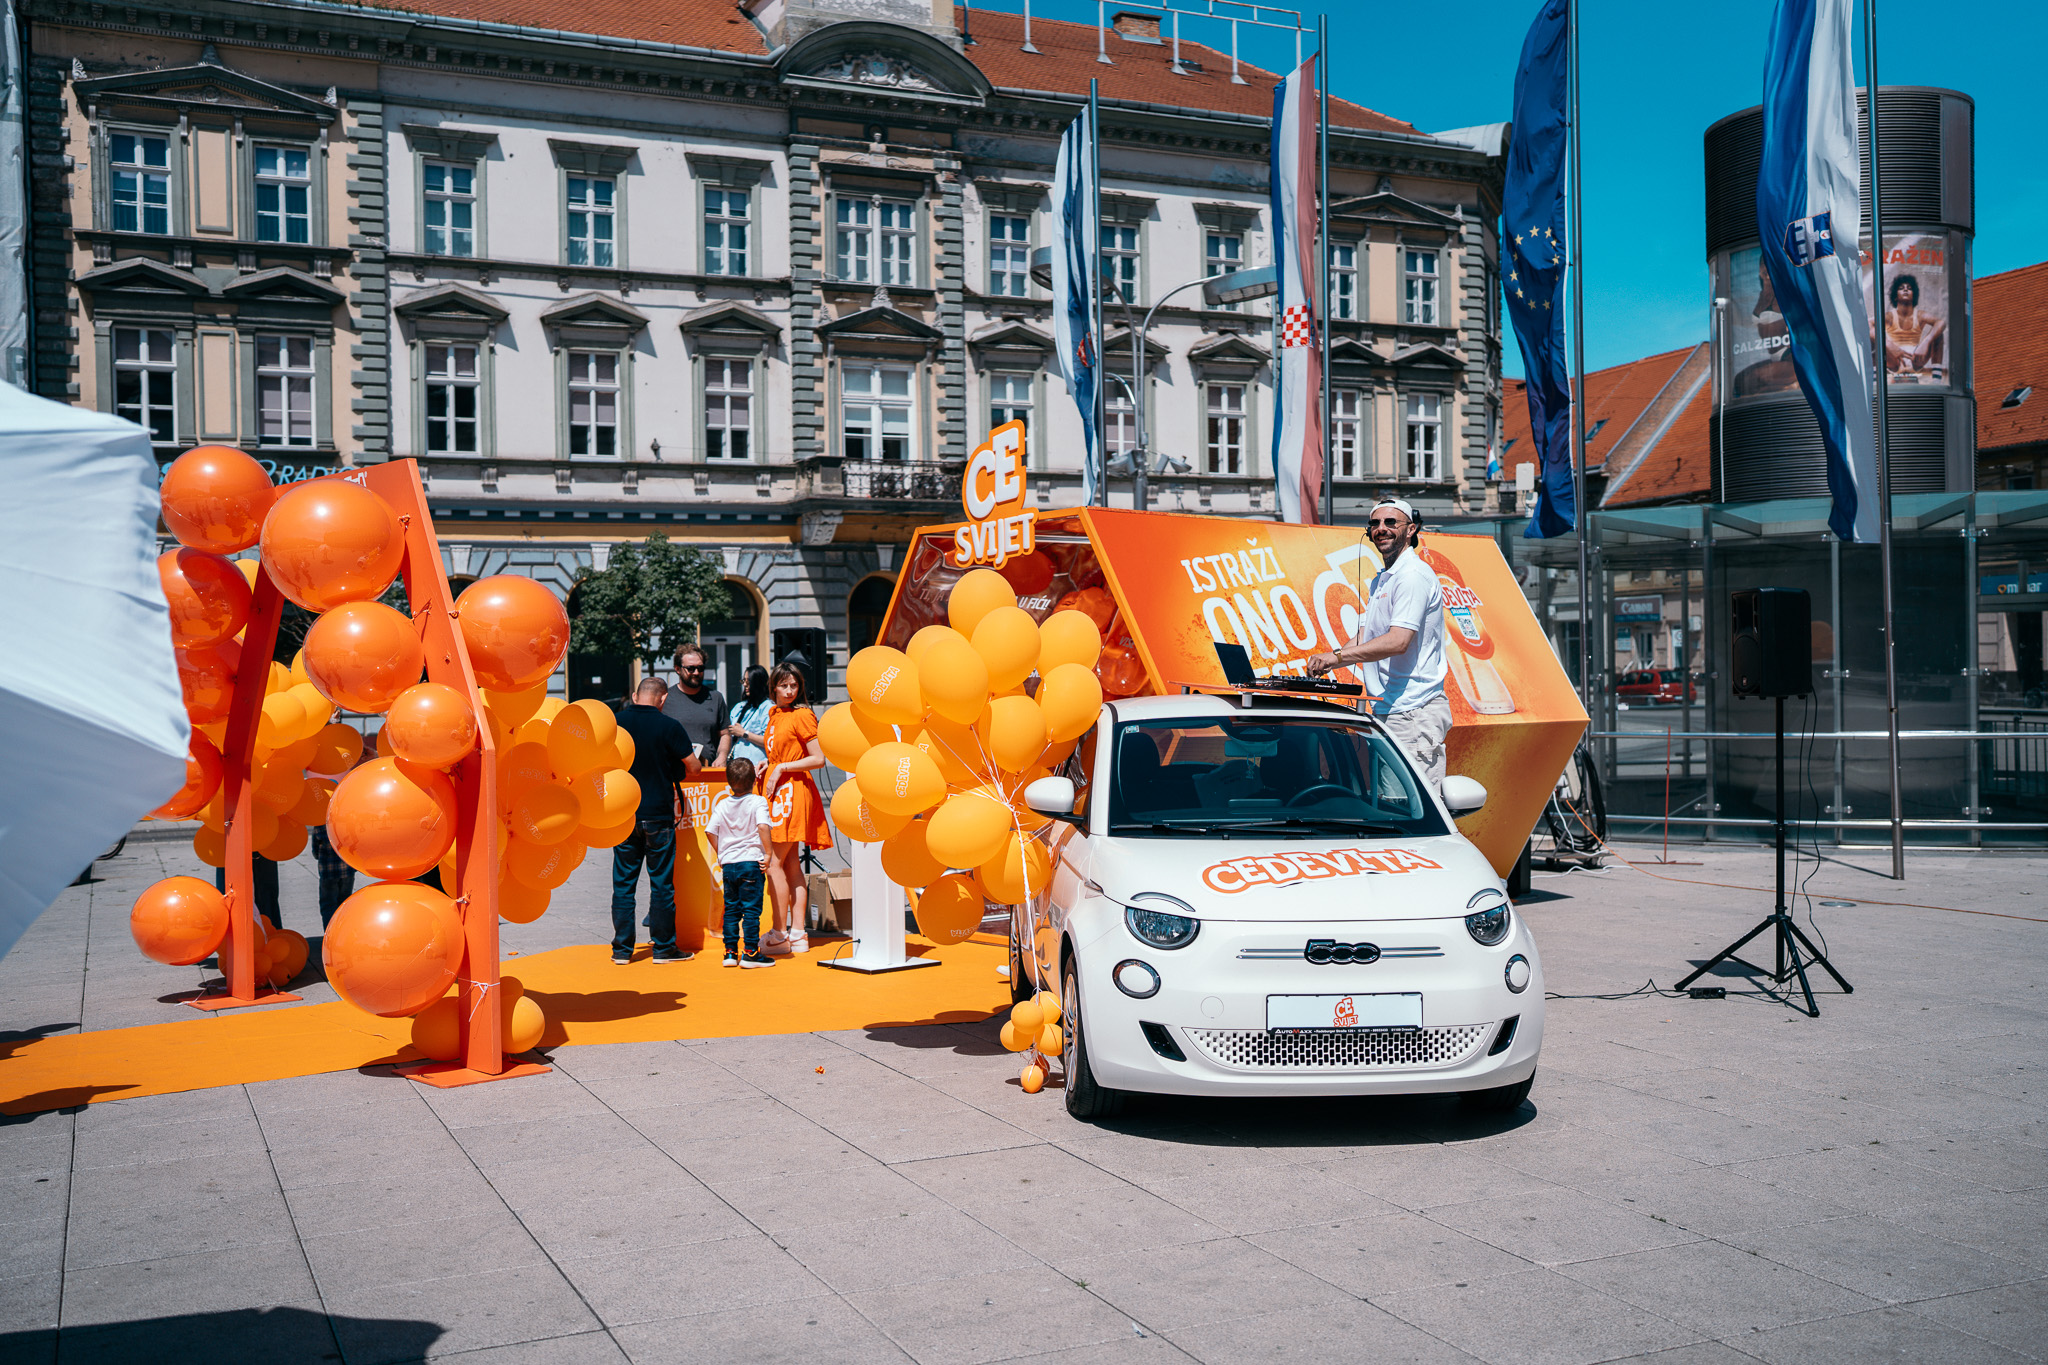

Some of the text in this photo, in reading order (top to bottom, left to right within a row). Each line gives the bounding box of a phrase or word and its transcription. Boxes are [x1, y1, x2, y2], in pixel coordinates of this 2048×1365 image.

[1733, 334, 1791, 355] CALZEDO
[966, 427, 1020, 519] CE
[956, 512, 1035, 565] SVIJET
[1180, 537, 1286, 594] ISTRAŽI
[1441, 585, 1483, 609] DEVITA
[1621, 602, 1653, 614] Canon
[1202, 585, 1318, 661] ONO
[871, 666, 900, 704] CEDEVITA
[896, 756, 911, 798] CEDEVITA
[1202, 848, 1444, 894] CEDEVITA
[1304, 938, 1382, 965] 500
[1333, 1014, 1358, 1027] SVIJET
[1335, 997, 1354, 1018] CE
